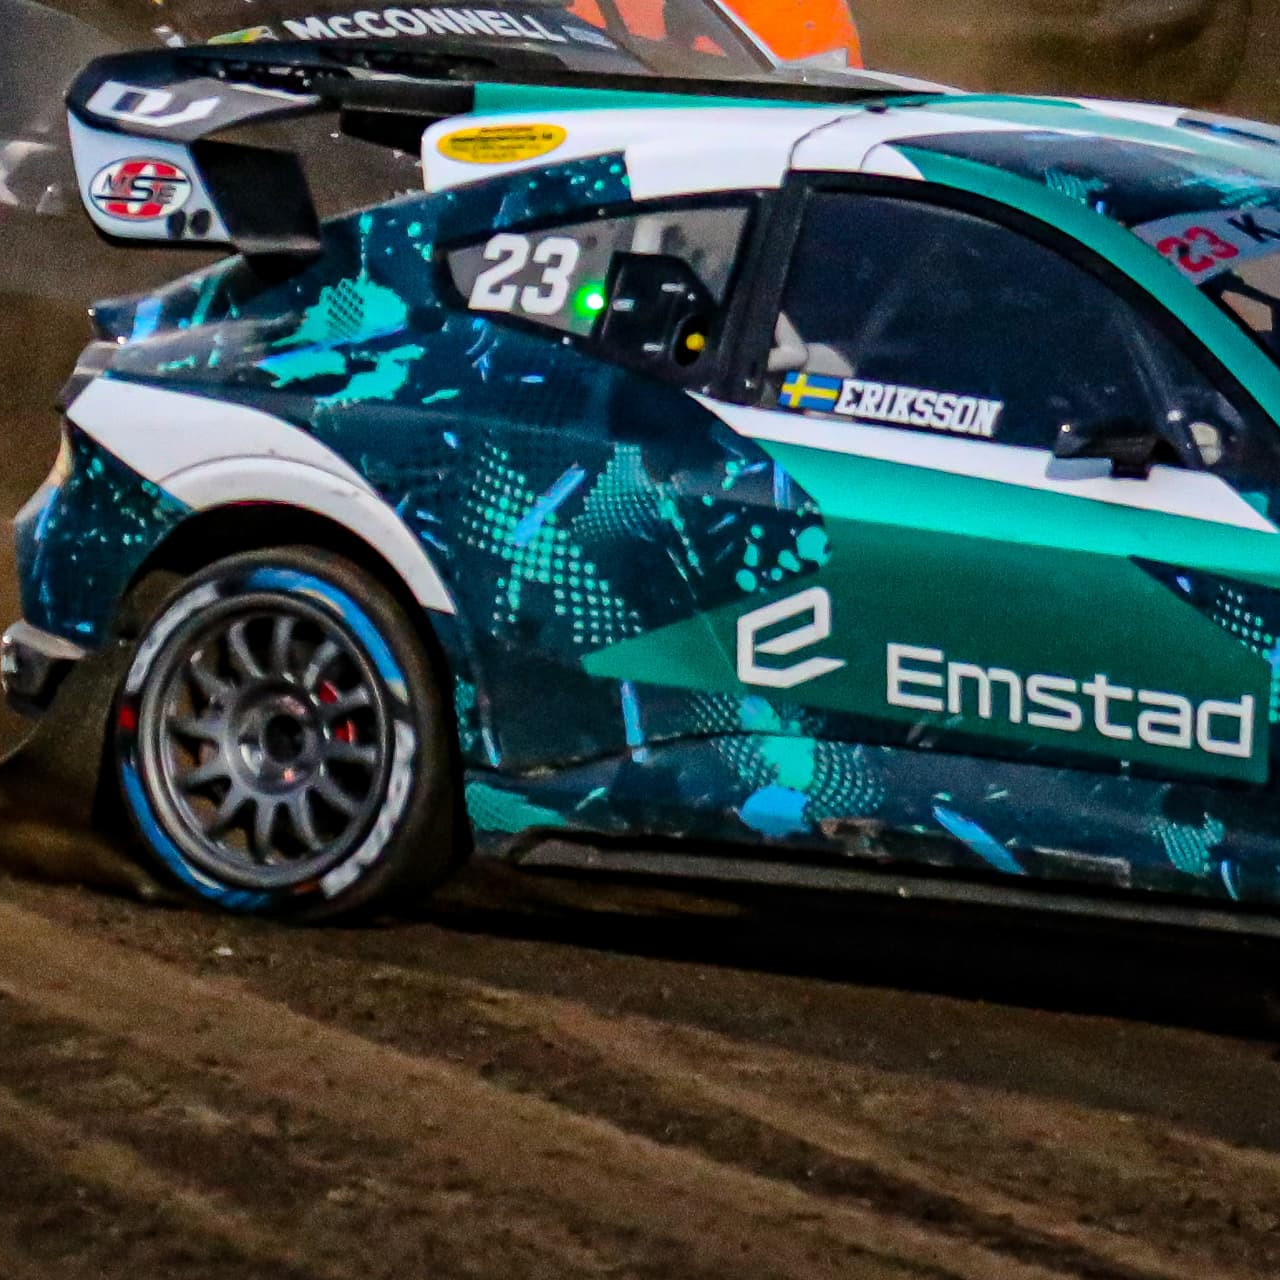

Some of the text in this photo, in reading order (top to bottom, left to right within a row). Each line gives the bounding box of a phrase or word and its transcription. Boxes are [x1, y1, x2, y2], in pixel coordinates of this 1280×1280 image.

[282, 7, 568, 42] McCONNELL
[467, 232, 581, 316] 23
[834, 377, 1004, 438] ERIKSSON
[886, 642, 1256, 758] Emstad
